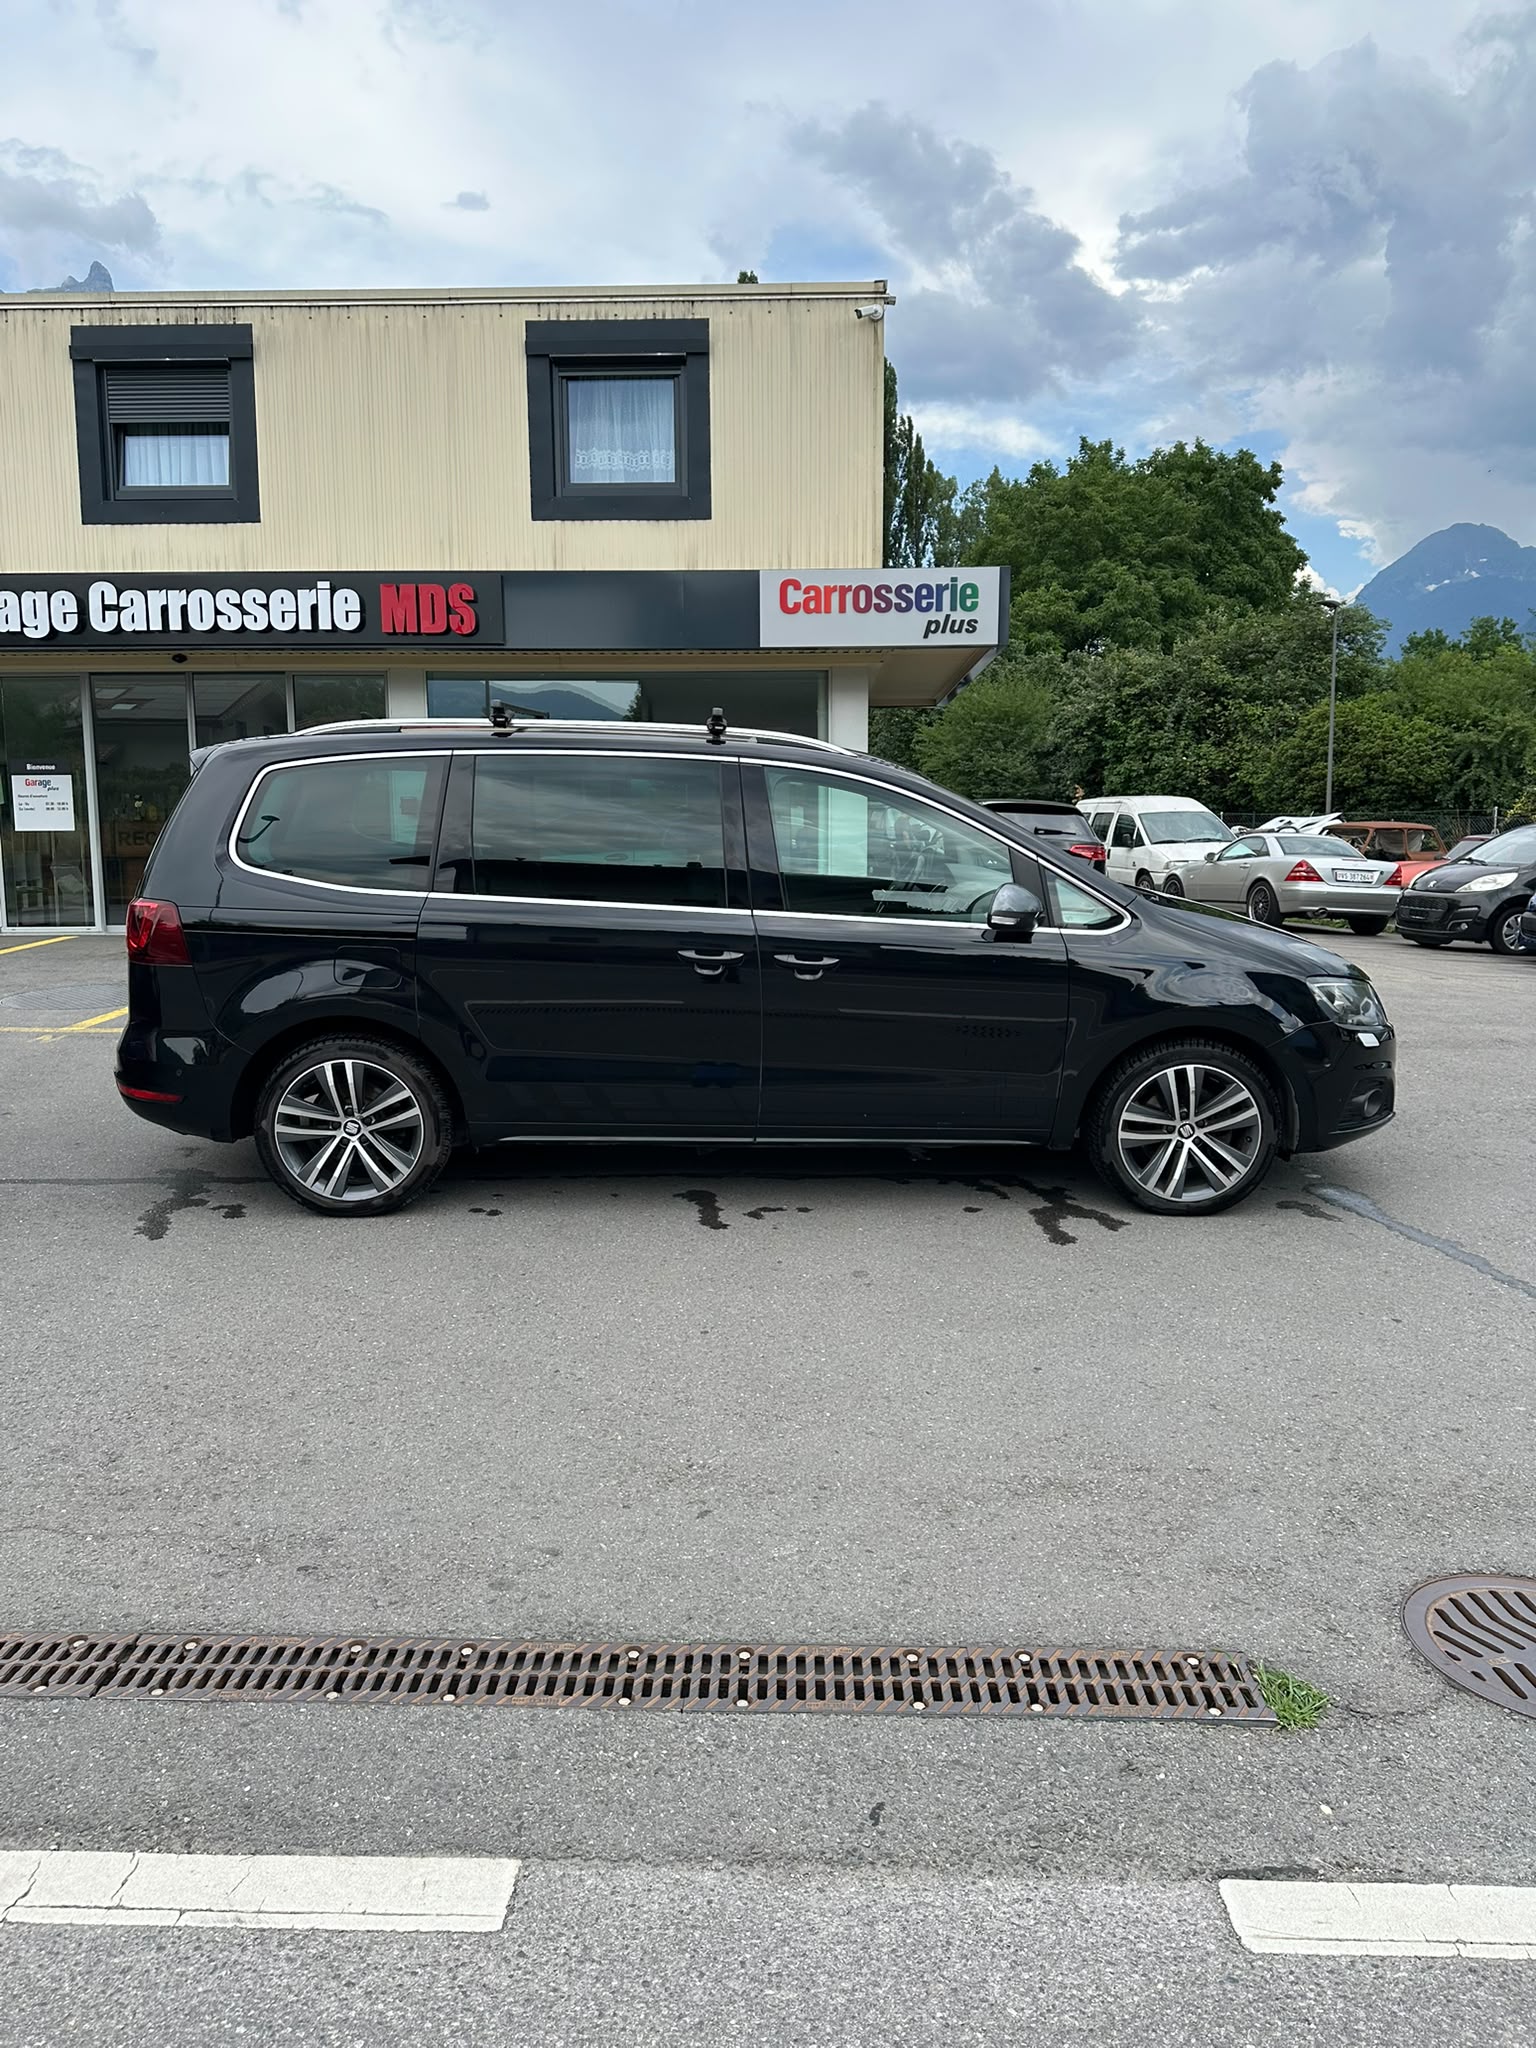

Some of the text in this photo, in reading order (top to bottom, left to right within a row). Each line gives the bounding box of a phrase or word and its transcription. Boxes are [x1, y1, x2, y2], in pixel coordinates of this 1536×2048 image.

[88, 580, 361, 633] Carrosserie
[380, 583, 476, 635] MDS
[779, 577, 980, 614] Carrosserie
[923, 614, 979, 638] plus
[25, 778, 51, 788] Garage
